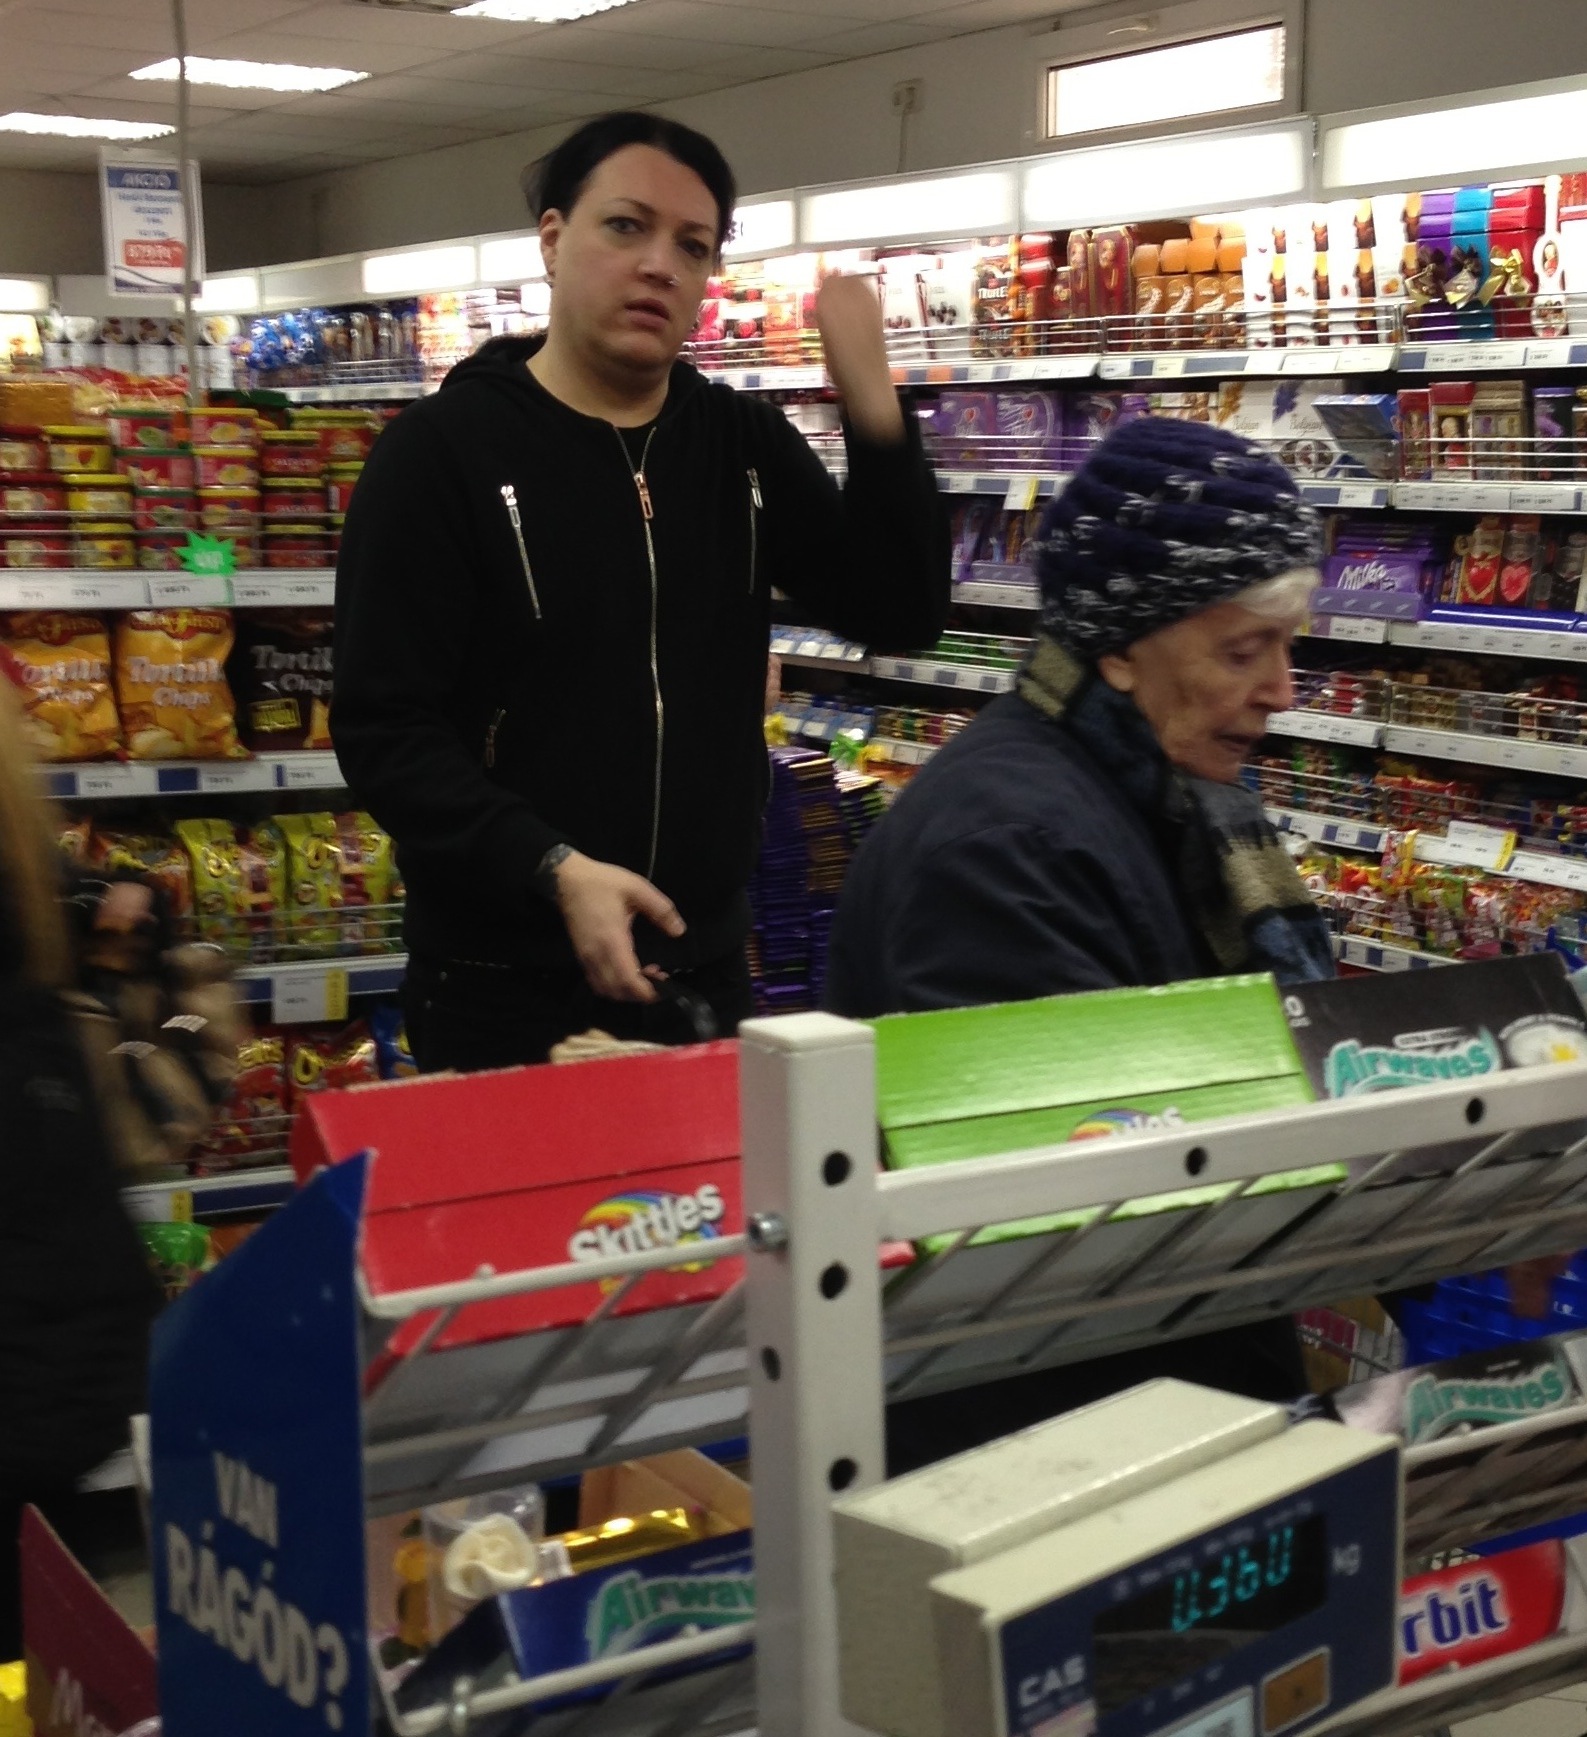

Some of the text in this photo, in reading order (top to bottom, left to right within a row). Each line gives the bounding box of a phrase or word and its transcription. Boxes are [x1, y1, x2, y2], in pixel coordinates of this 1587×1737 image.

[1336, 560, 1388, 591] Milka
[1325, 1037, 1496, 1098] Airwaves
[568, 1183, 725, 1262] Skittles
[1404, 1364, 1567, 1442] Airwaves
[214, 1451, 280, 1550] VAN
[166, 1520, 350, 1732] RÁGÓD?
[1402, 1577, 1506, 1656] rbit
[1018, 1654, 1086, 1707] CAS
